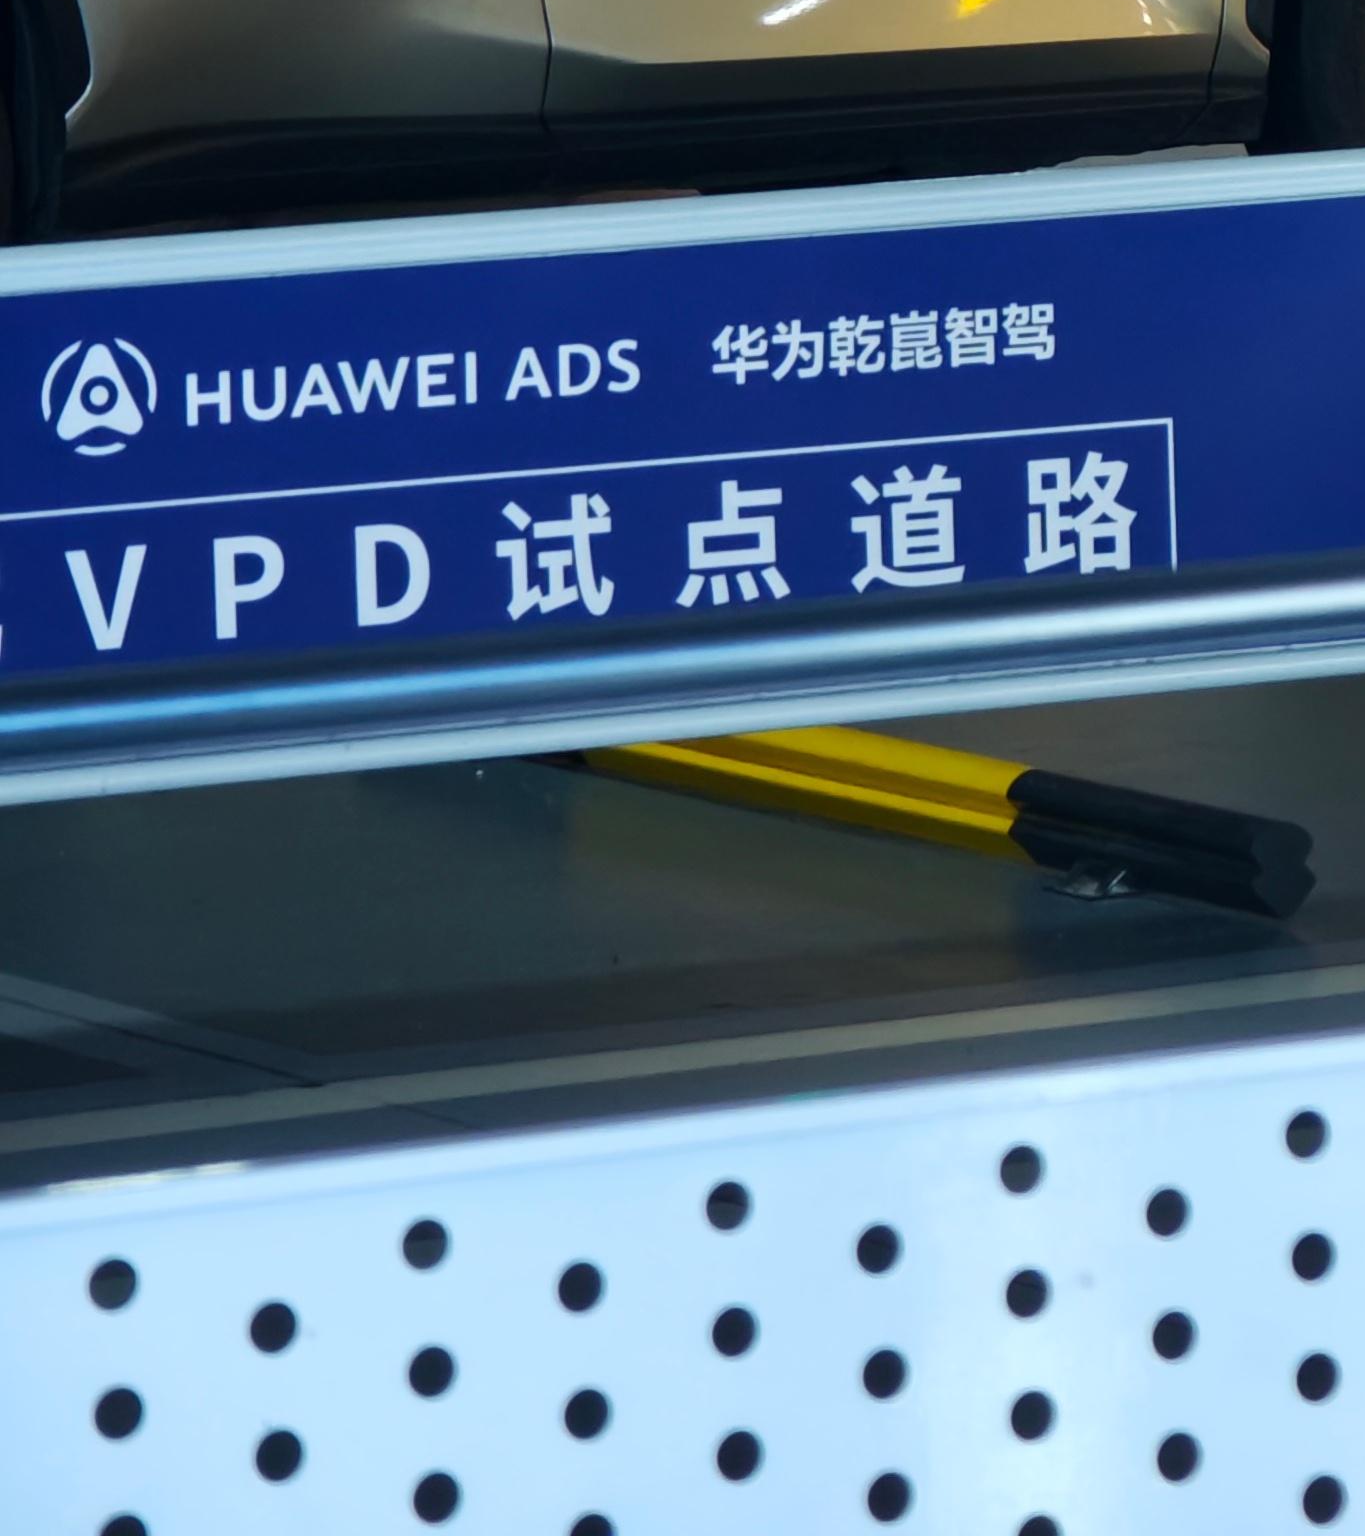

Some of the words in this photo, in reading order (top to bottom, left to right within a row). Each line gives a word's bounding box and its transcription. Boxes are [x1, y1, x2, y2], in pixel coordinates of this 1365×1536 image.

[185, 351, 478, 428] HUAWEI
[505, 339, 641, 401] ADS
[711, 302, 1056, 385] 华为乾崑智驾
[0, 451, 1138, 651] VPD试点道路
